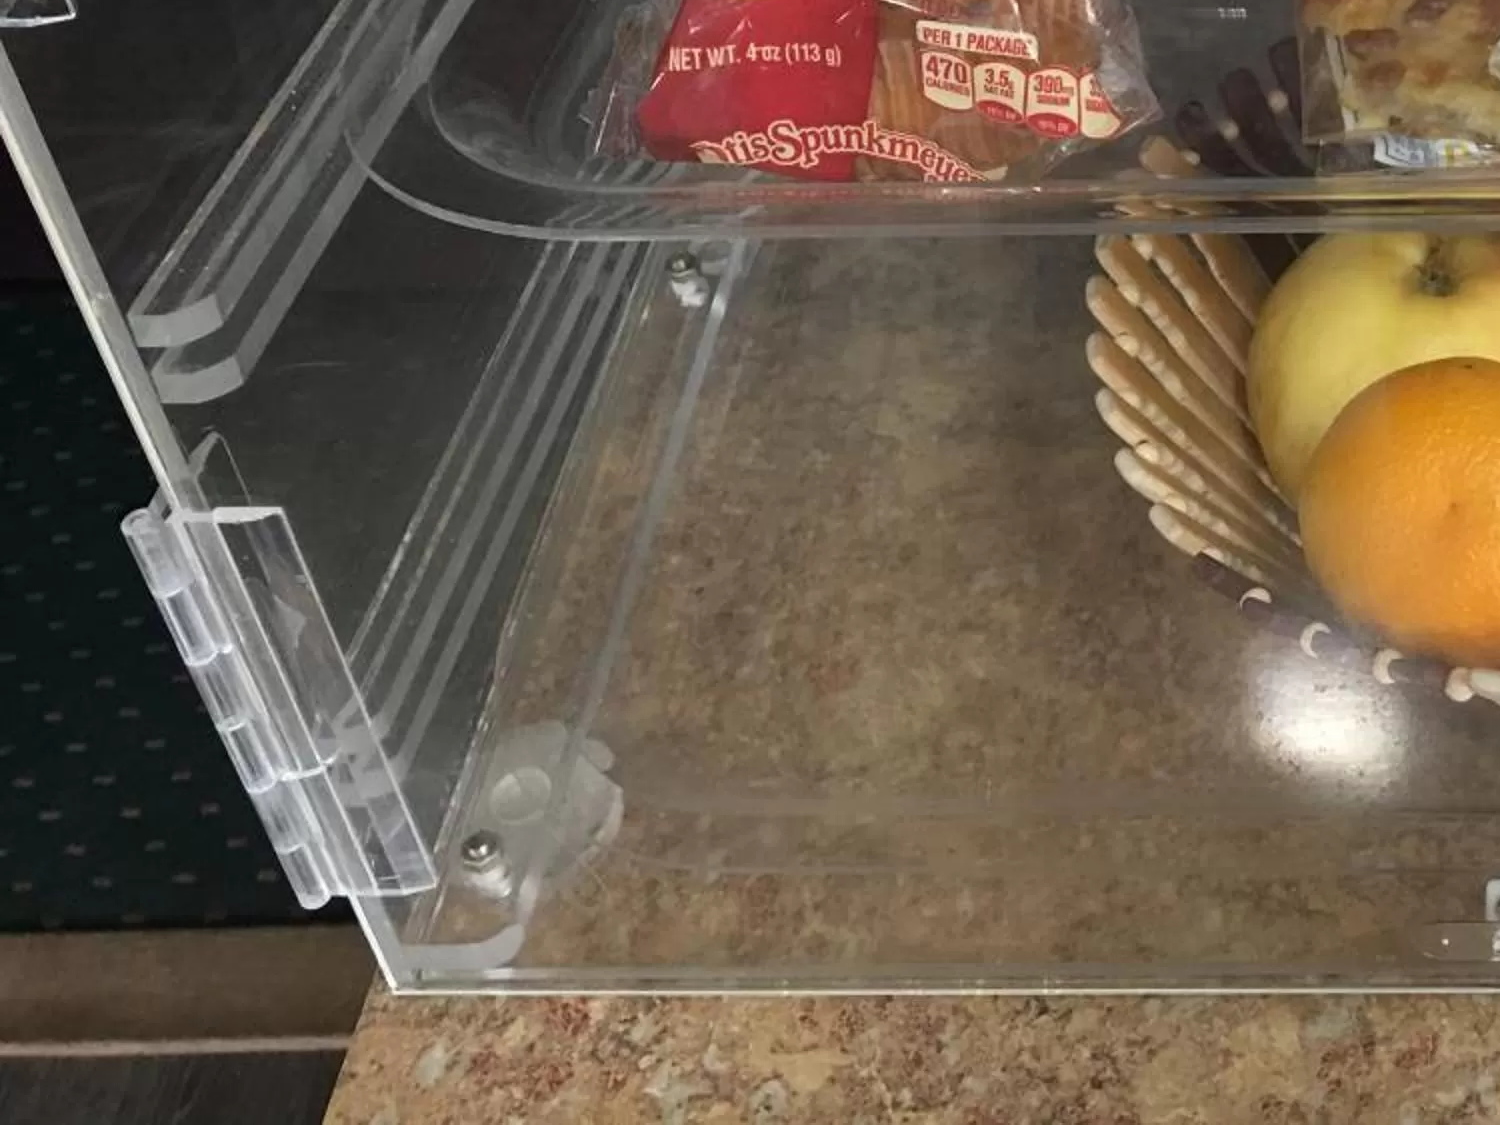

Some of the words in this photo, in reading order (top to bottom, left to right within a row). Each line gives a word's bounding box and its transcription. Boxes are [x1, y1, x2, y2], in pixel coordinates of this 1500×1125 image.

[922, 26, 952, 46] PER
[954, 33, 963, 48] 1
[668, 46, 702, 72] NET
[705, 44, 742, 68] WT.
[745, 42, 757, 62] 4
[785, 42, 822, 66] (113
[825, 44, 842, 67] g)
[925, 56, 968, 84] 470
[767, 120, 985, 182] Spunkmeye
